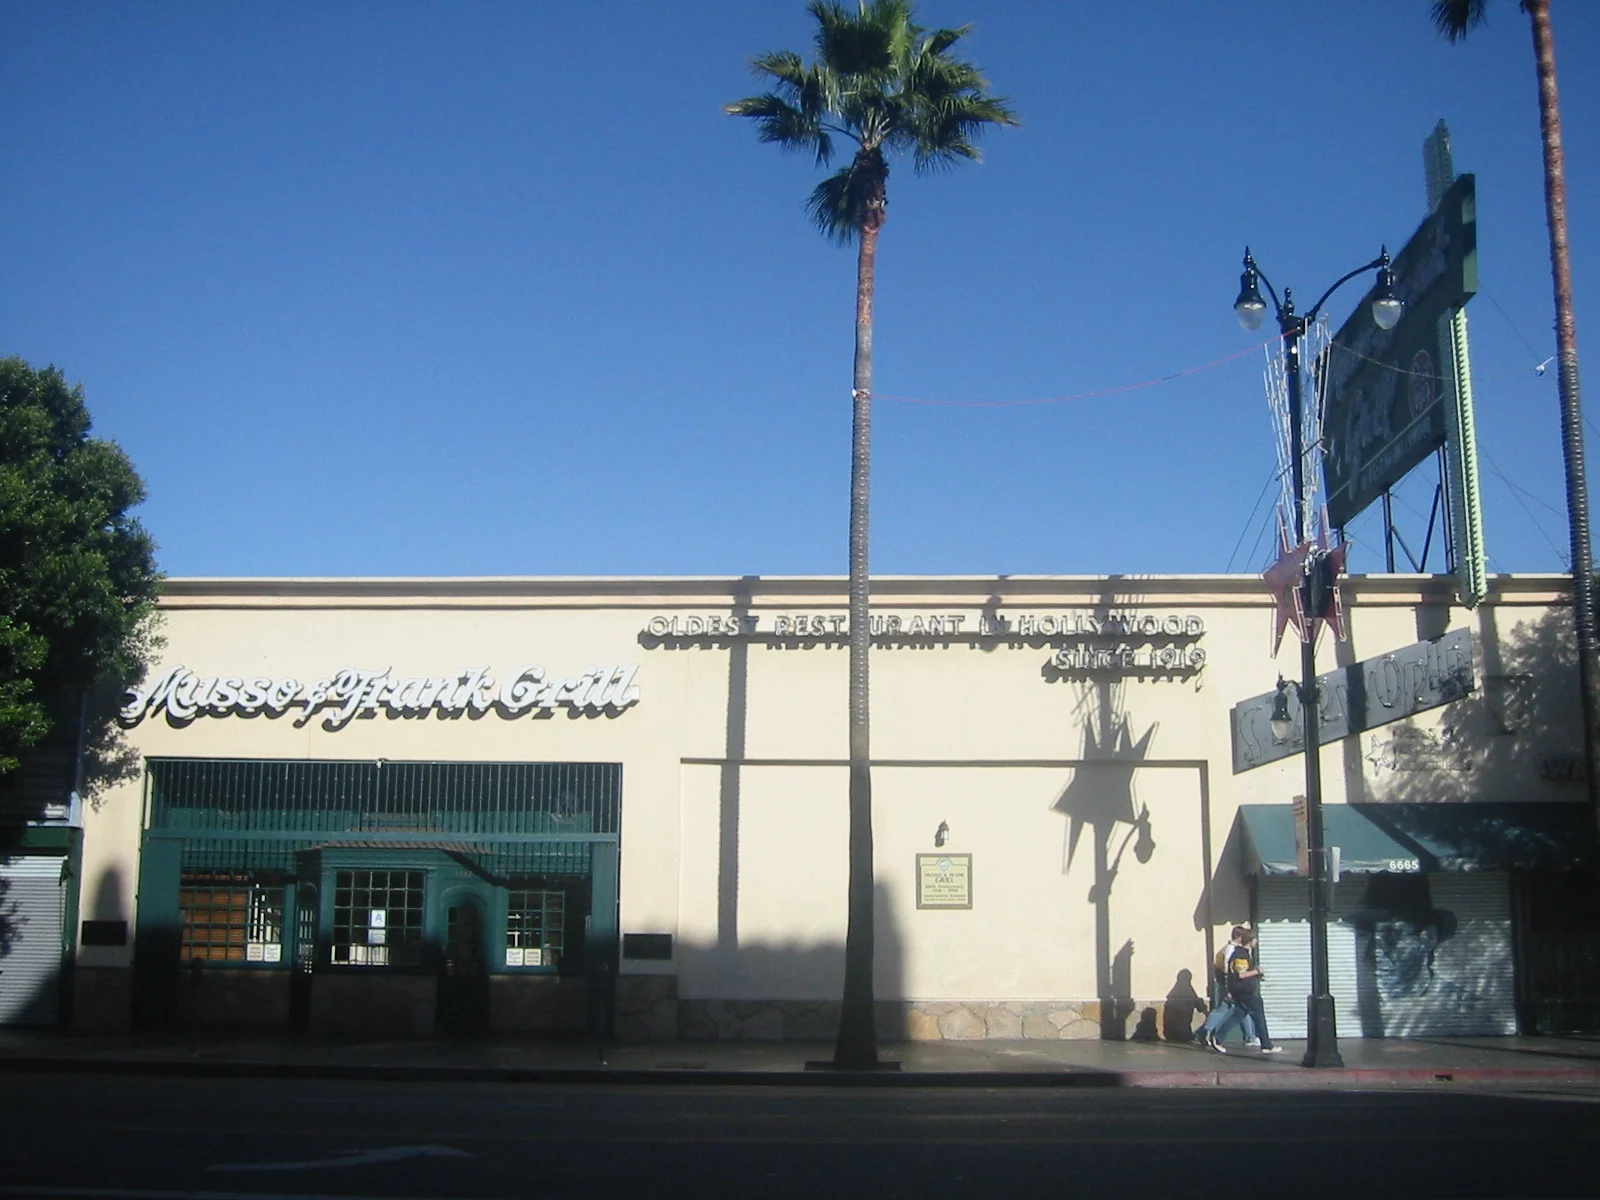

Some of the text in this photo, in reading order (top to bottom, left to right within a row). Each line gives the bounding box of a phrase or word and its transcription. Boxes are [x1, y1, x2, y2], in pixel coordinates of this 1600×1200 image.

[649, 615, 759, 636] OLDEST
[774, 615, 964, 636] RESTURANT
[1019, 615, 1204, 636] HOLLYWOOD
[1055, 647, 1206, 670] SINCE 1919
[120, 663, 304, 719] Musso
[329, 664, 495, 722] Frank
[499, 663, 640, 708] Grill
